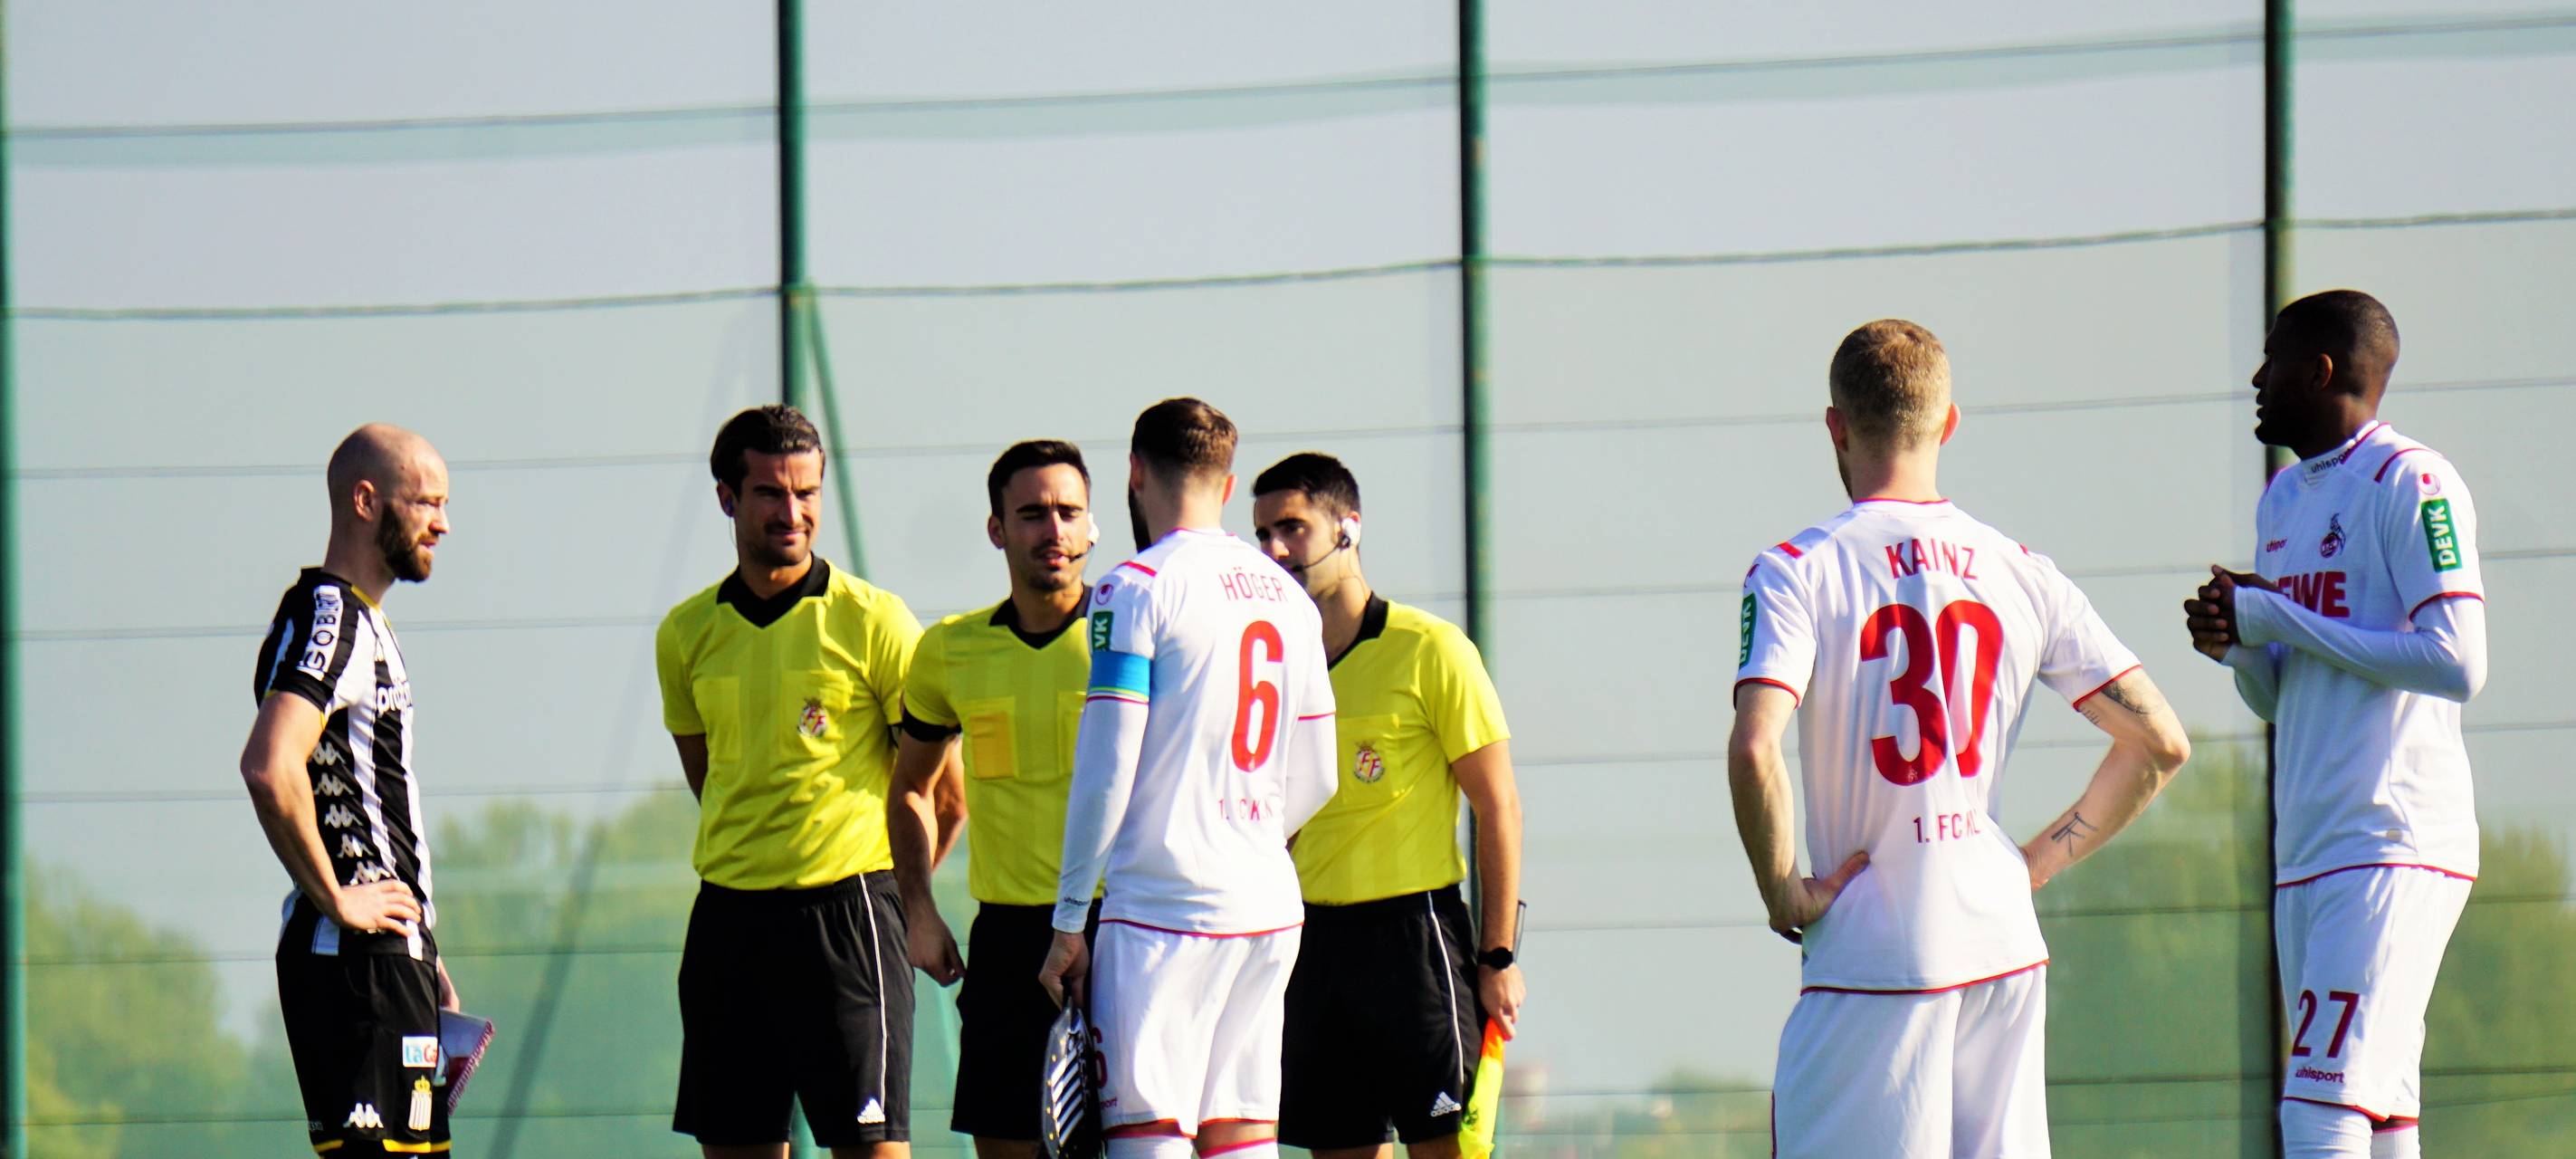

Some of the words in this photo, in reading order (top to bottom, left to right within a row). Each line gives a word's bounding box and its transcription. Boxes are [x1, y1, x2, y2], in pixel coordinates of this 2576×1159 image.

[2428, 505, 2457, 566] DEVK
[1885, 538, 1978, 580] KAINZ
[1218, 566, 1288, 602] HÖGER
[2277, 571, 2351, 618] EWE
[1094, 618, 1108, 649] VK
[1232, 620, 1283, 772] 6
[1860, 599, 2004, 786] 30
[1913, 817, 1930, 843] 1.
[1938, 813, 1962, 840] FC
[2292, 990, 2361, 1058] 27
[2295, 1067, 2344, 1084] uhlsport
